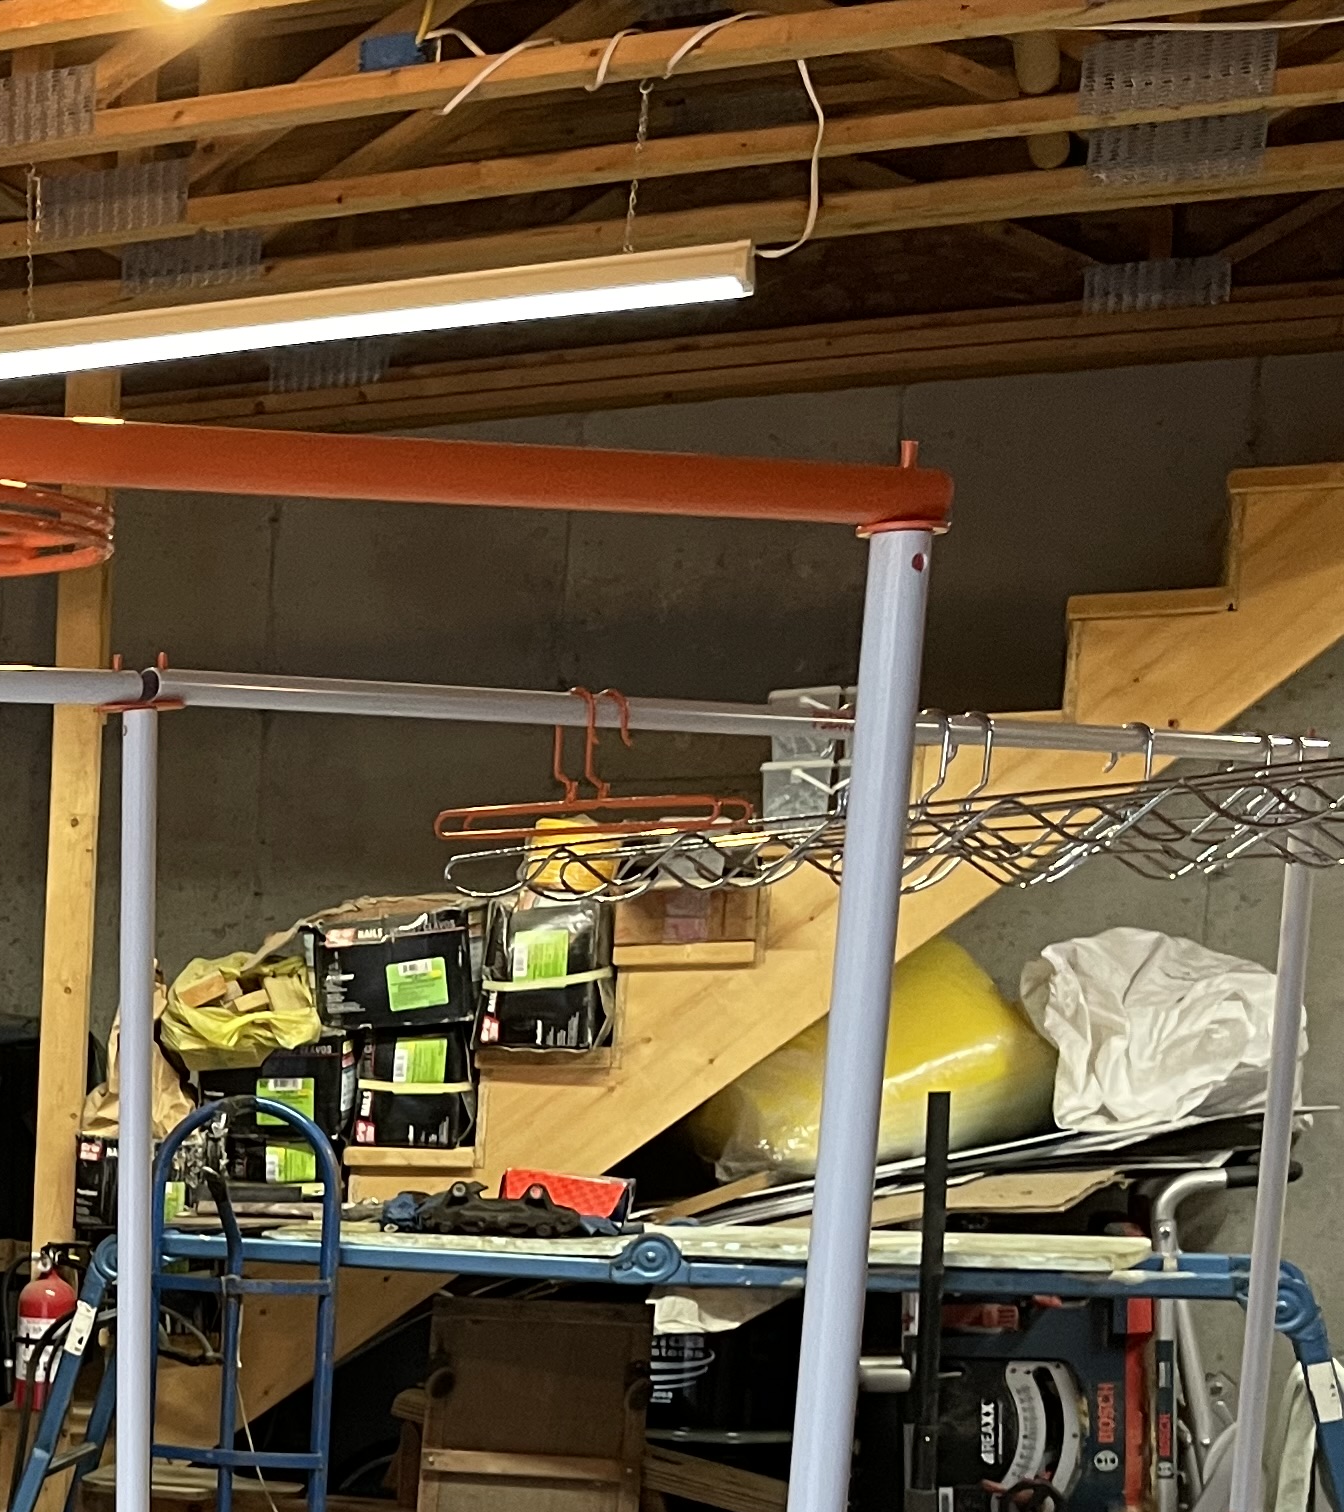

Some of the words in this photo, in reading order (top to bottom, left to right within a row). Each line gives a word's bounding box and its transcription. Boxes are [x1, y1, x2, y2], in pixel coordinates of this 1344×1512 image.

[981, 1401, 996, 1452] REAXX
[1098, 1382, 1115, 1444] BOSCH
[1158, 1413, 1170, 1457] BOSCH
